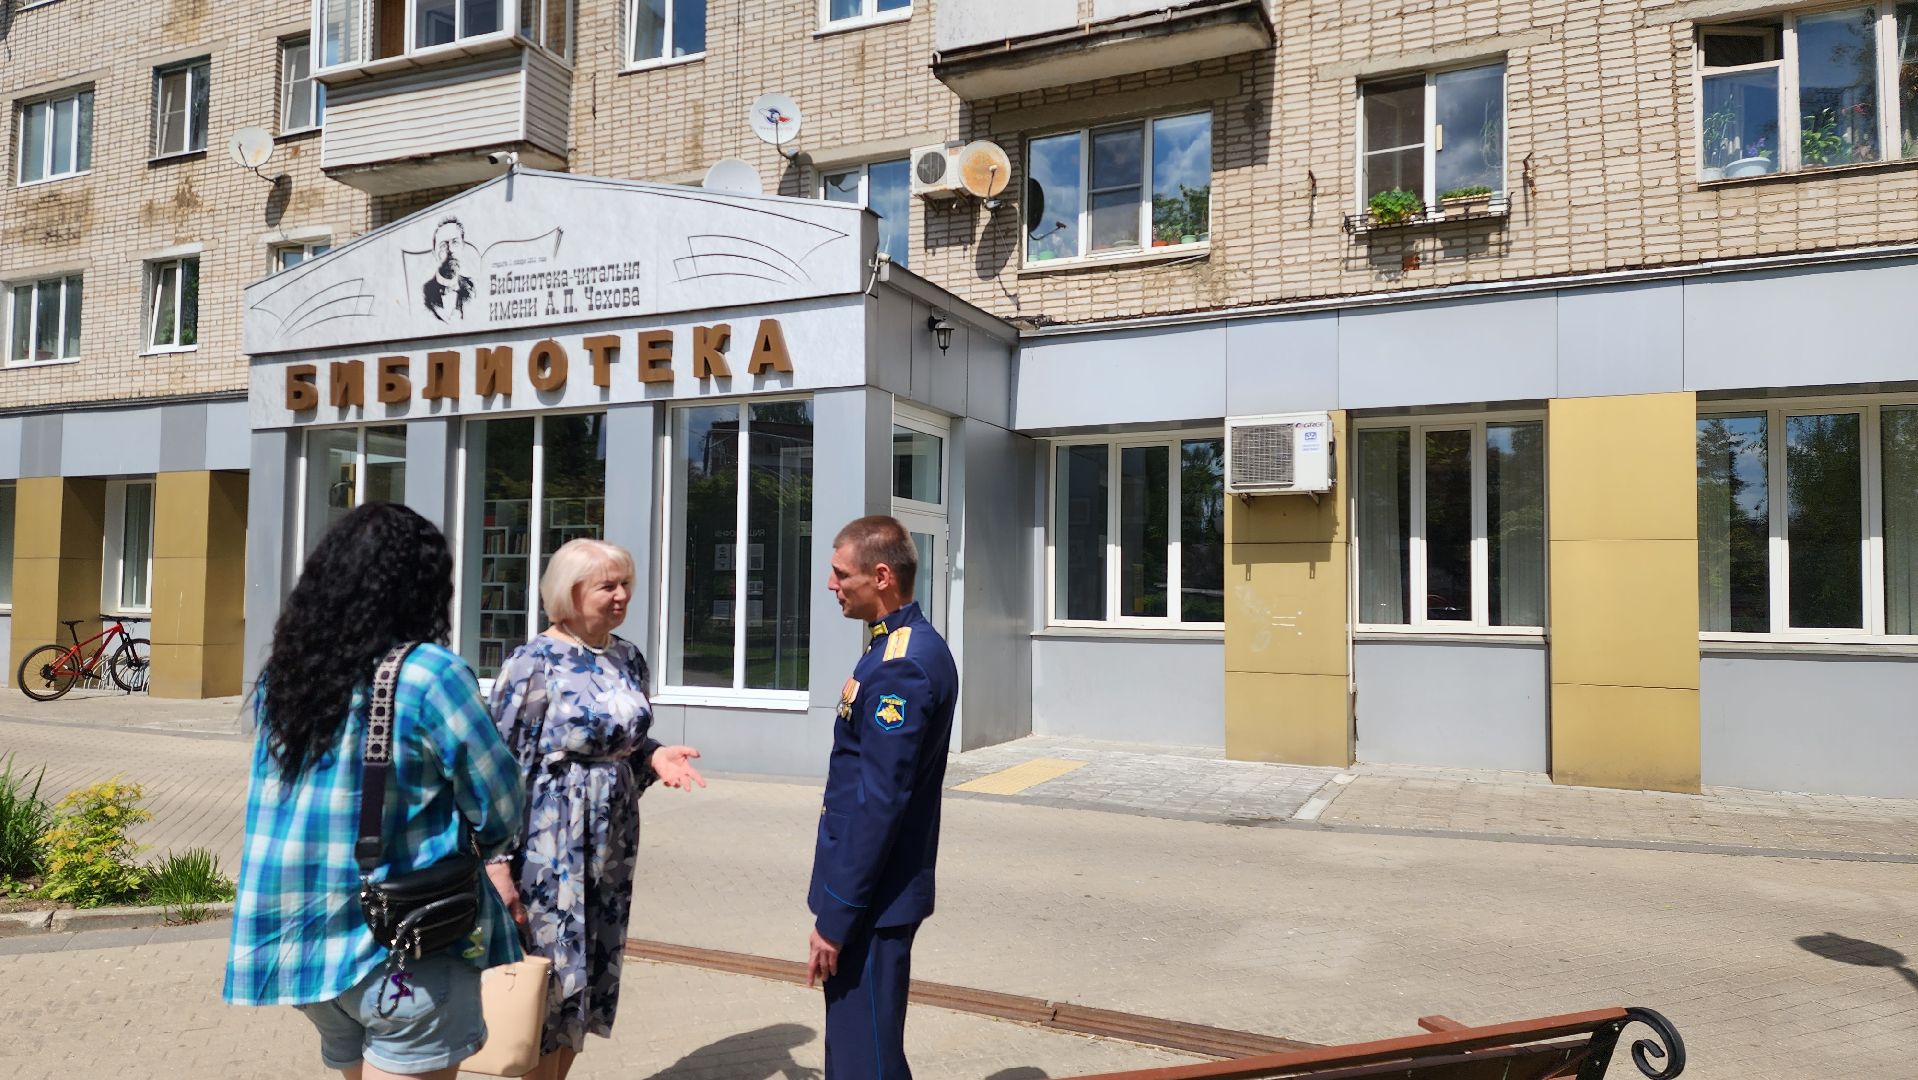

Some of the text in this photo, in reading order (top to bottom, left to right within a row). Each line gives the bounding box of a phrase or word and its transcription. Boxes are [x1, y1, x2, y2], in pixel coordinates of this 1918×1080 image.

[489, 261, 640, 296] Библиотека-читальня
[489, 297, 538, 321] имени
[584, 286, 640, 311] Чехова
[285, 318, 794, 411] БИБЛИОТЕКА
